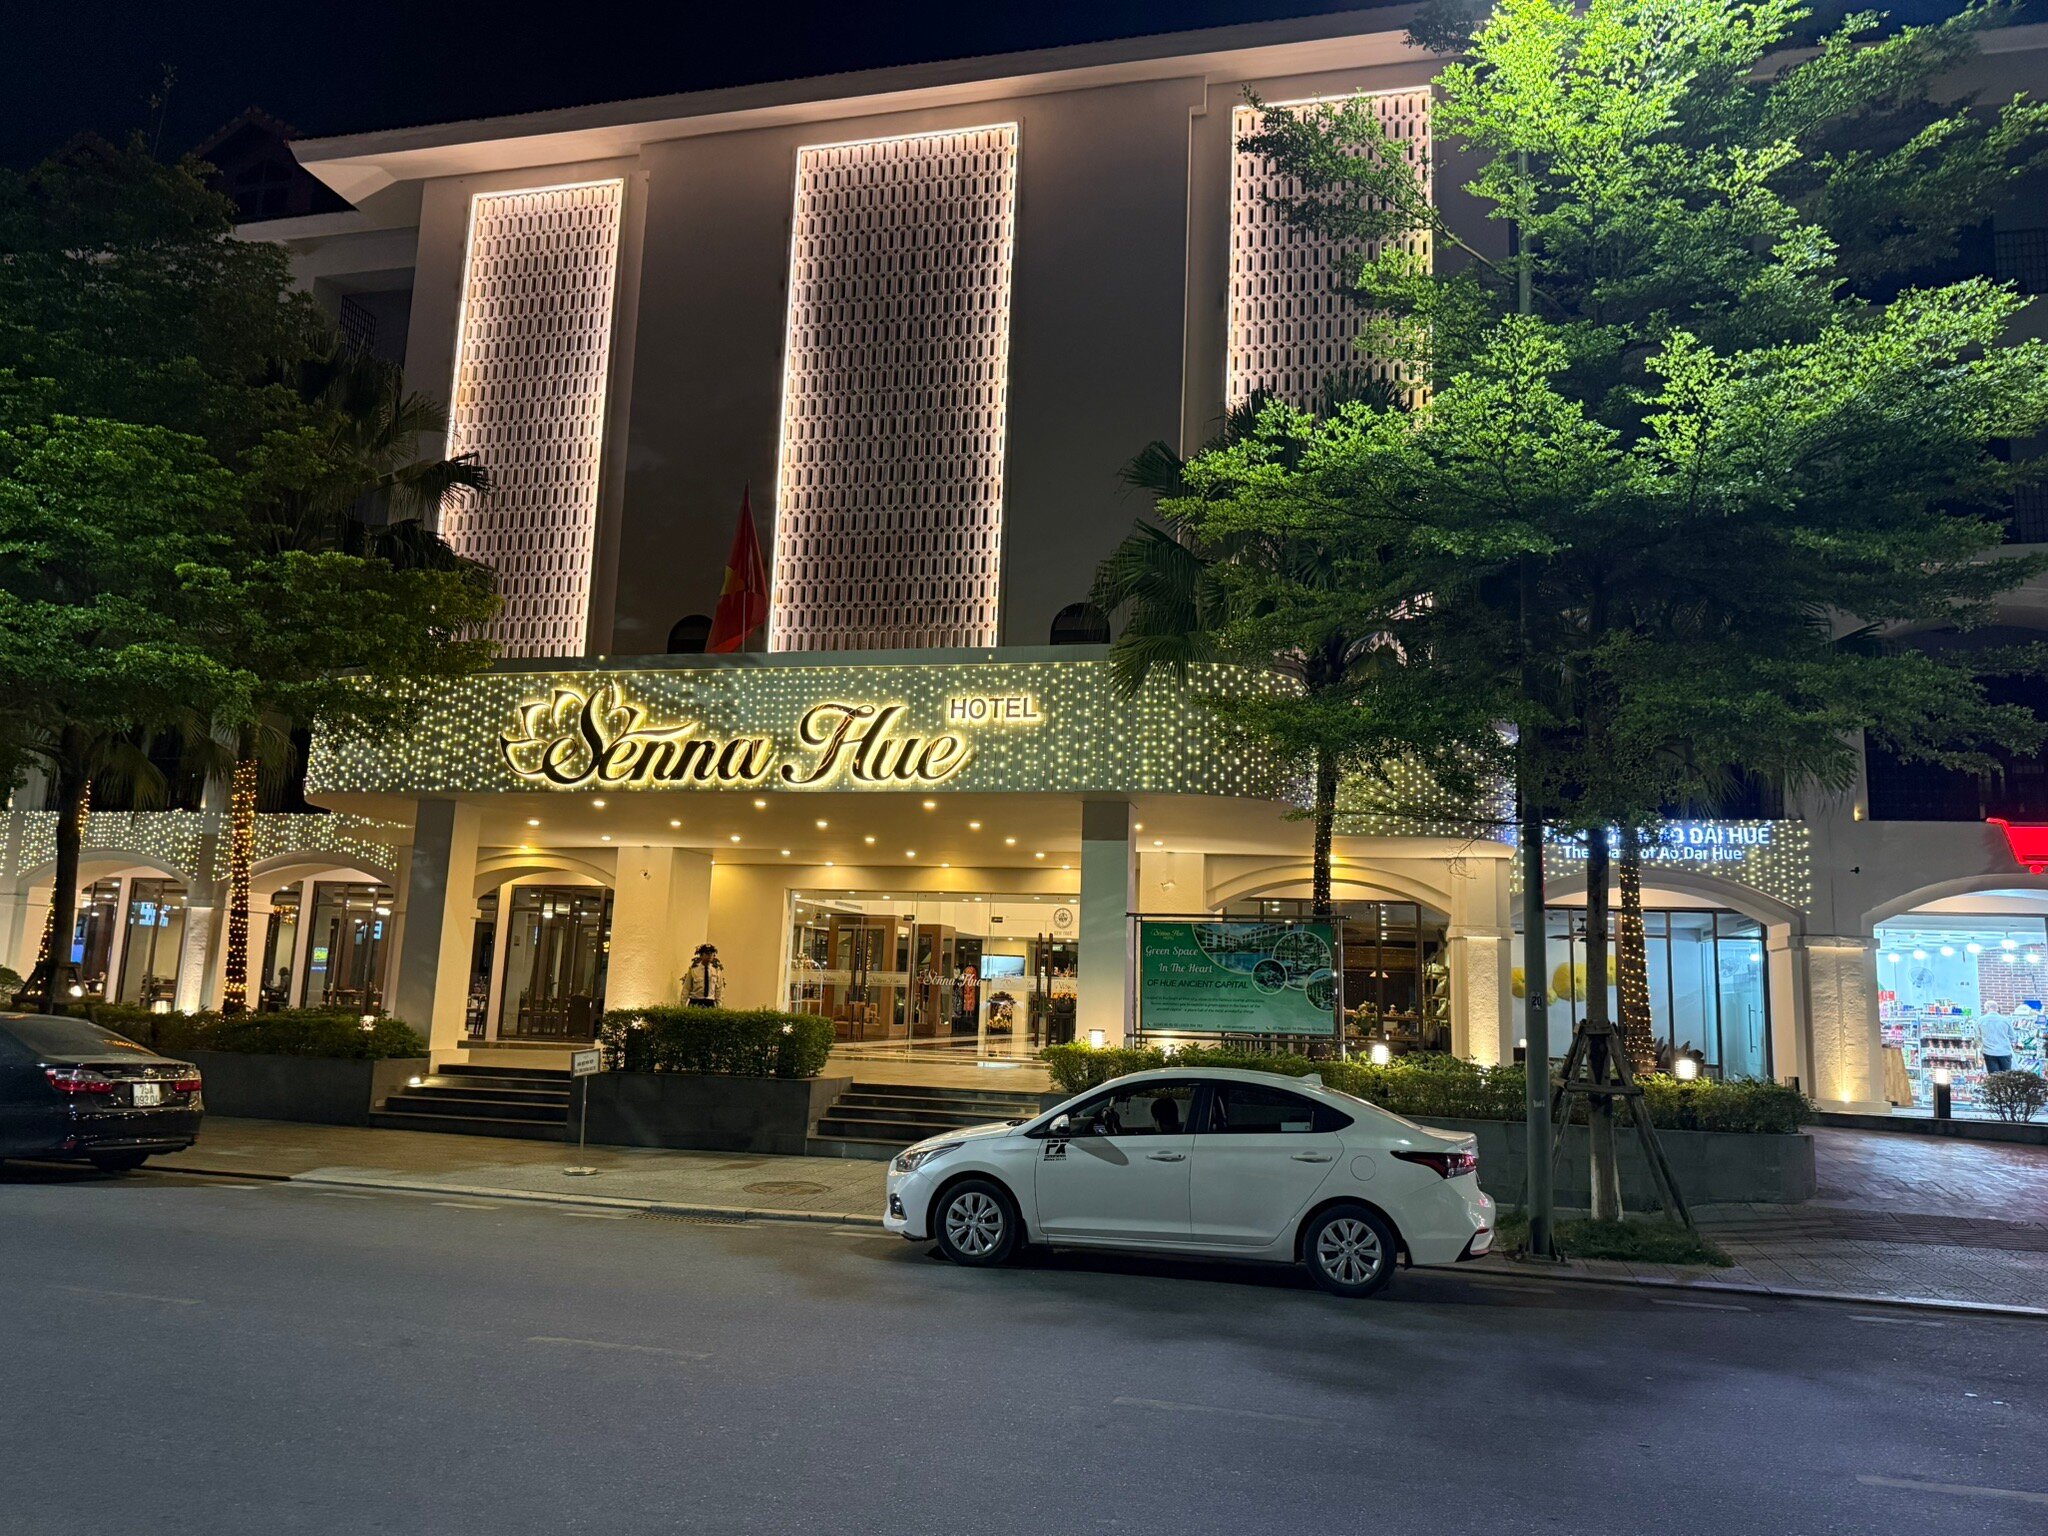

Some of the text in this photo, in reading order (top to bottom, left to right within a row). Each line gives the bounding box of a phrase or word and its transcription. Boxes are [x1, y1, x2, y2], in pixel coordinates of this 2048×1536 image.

[950, 697, 1038, 720] HOTEL
[500, 684, 970, 785] Senna Hue
[1562, 845, 1590, 859] The
[1640, 846, 1656, 859] of
[1660, 846, 1680, 860] Ao
[1712, 847, 1743, 860] Hue
[1145, 945, 1199, 958] Green Space
[1158, 963, 1213, 973] In The Heart
[1147, 979, 1249, 989] OF HUE ANCIENT CAPITAL
